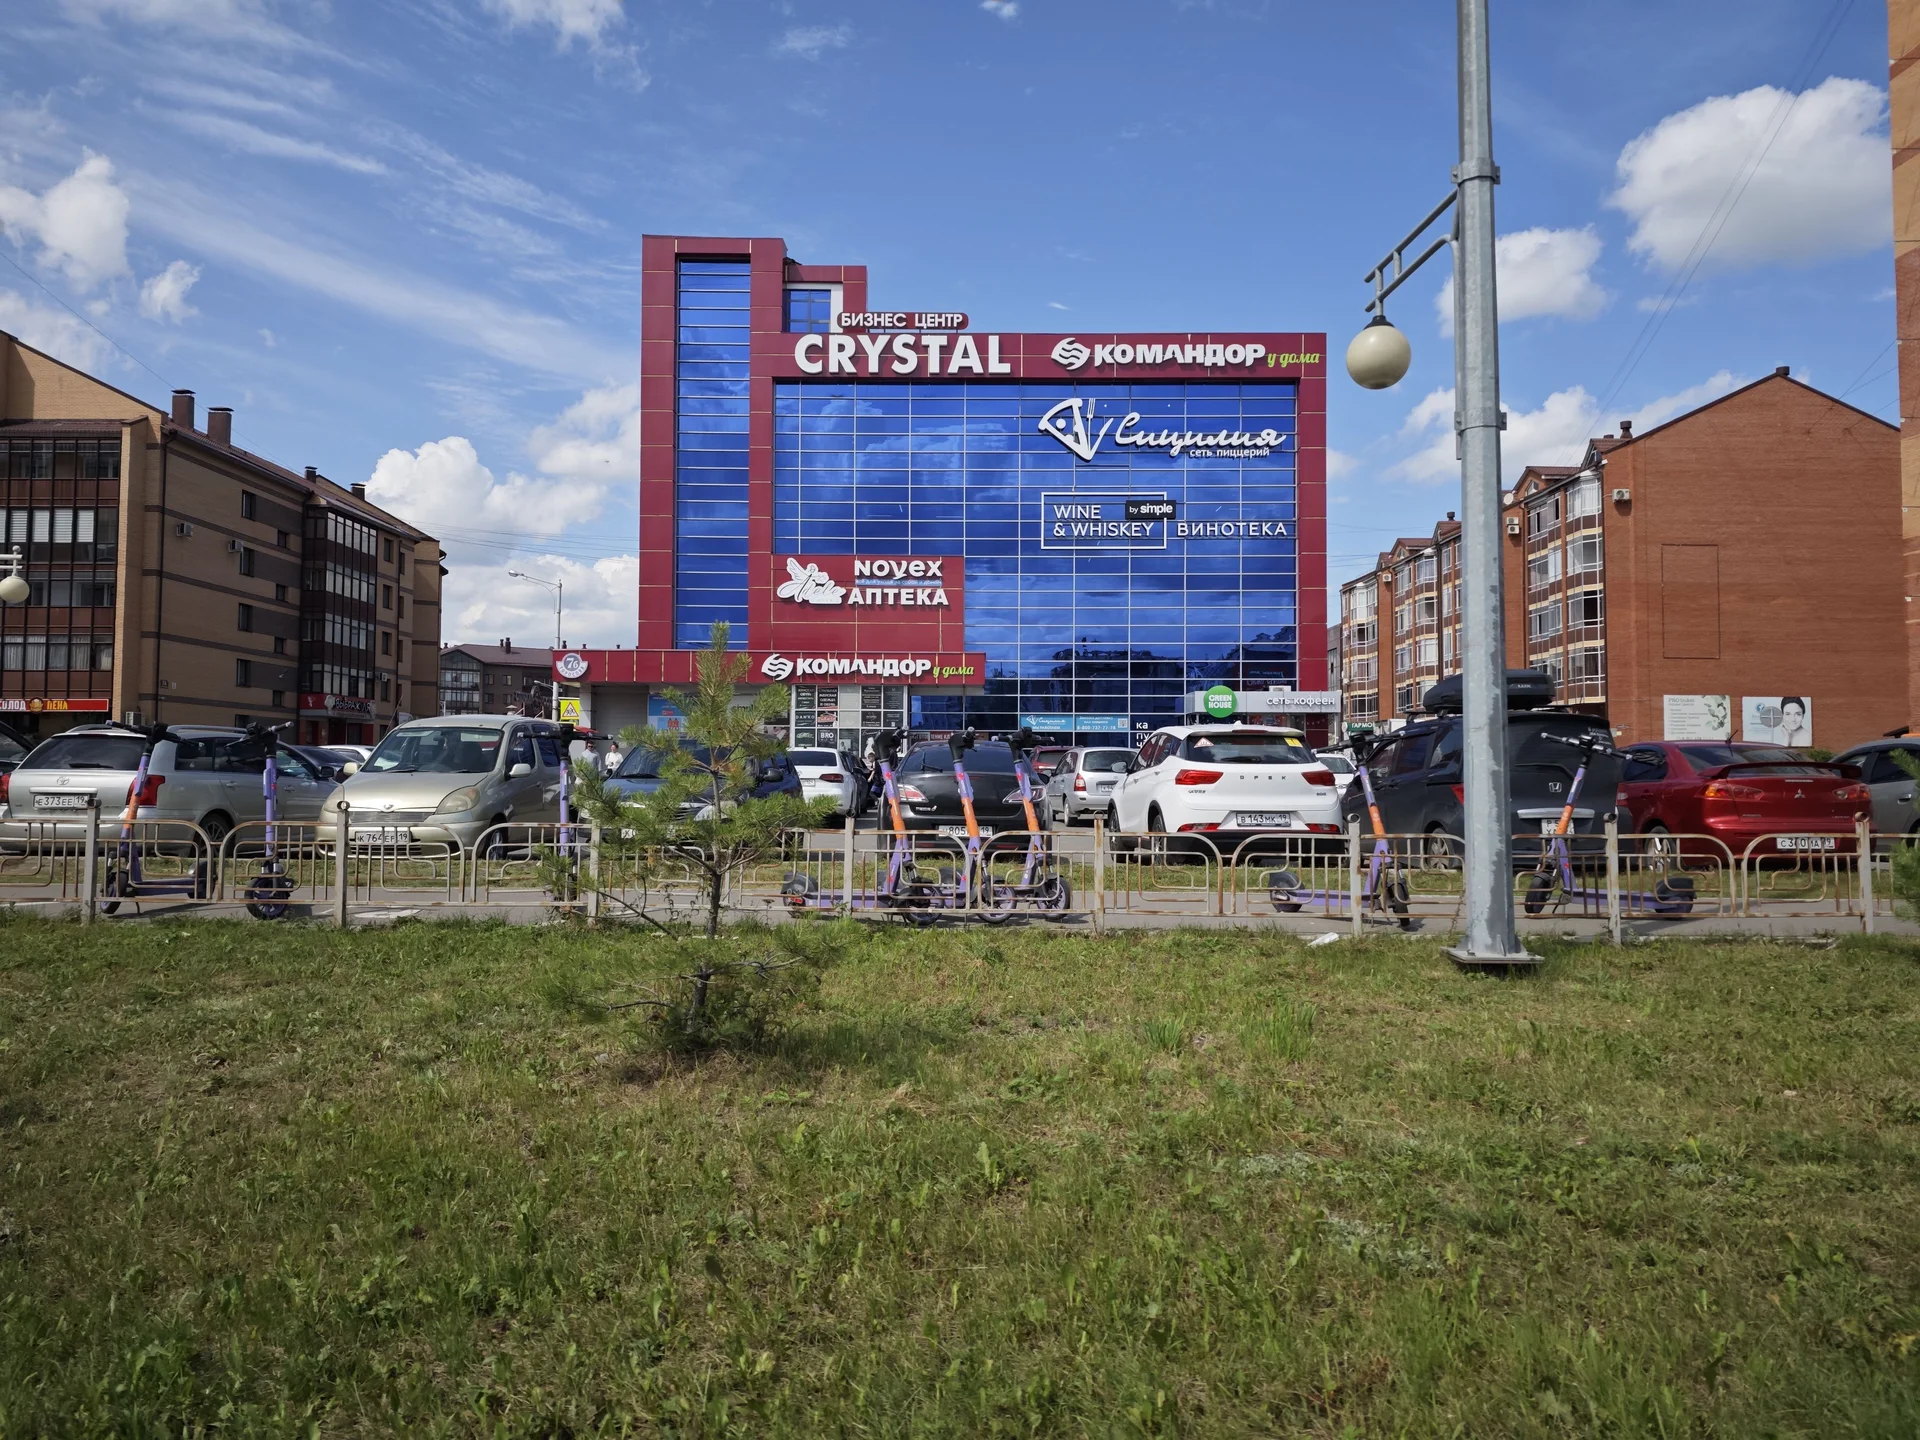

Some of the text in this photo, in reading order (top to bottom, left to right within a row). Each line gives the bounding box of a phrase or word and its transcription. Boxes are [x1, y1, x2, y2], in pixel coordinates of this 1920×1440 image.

[841, 313, 963, 329] БИЗНЕС ЦЕНТР
[794, 334, 1011, 374] CRYSTAL
[1094, 343, 1320, 367] КОМАНДОР у дома
[1115, 412, 1287, 456] Сицилия
[1190, 447, 1270, 458] сеть пиццерий
[1053, 504, 1102, 519] WINE
[1129, 503, 1173, 515] by simple
[1053, 522, 1154, 537] & WHISKEY
[1177, 522, 1287, 536] ВИНОТЕКА
[848, 588, 949, 605] АПТЕКА
[566, 657, 579, 668] 76
[797, 658, 974, 677] КОМАНДОР у дома
[46, 700, 68, 710] ПЕНА
[1208, 701, 1232, 709] HOUSE
[1266, 695, 1335, 707] сеть кофеен
[1278, 814, 1287, 822] 19
[1781, 837, 1819, 847] С30А
